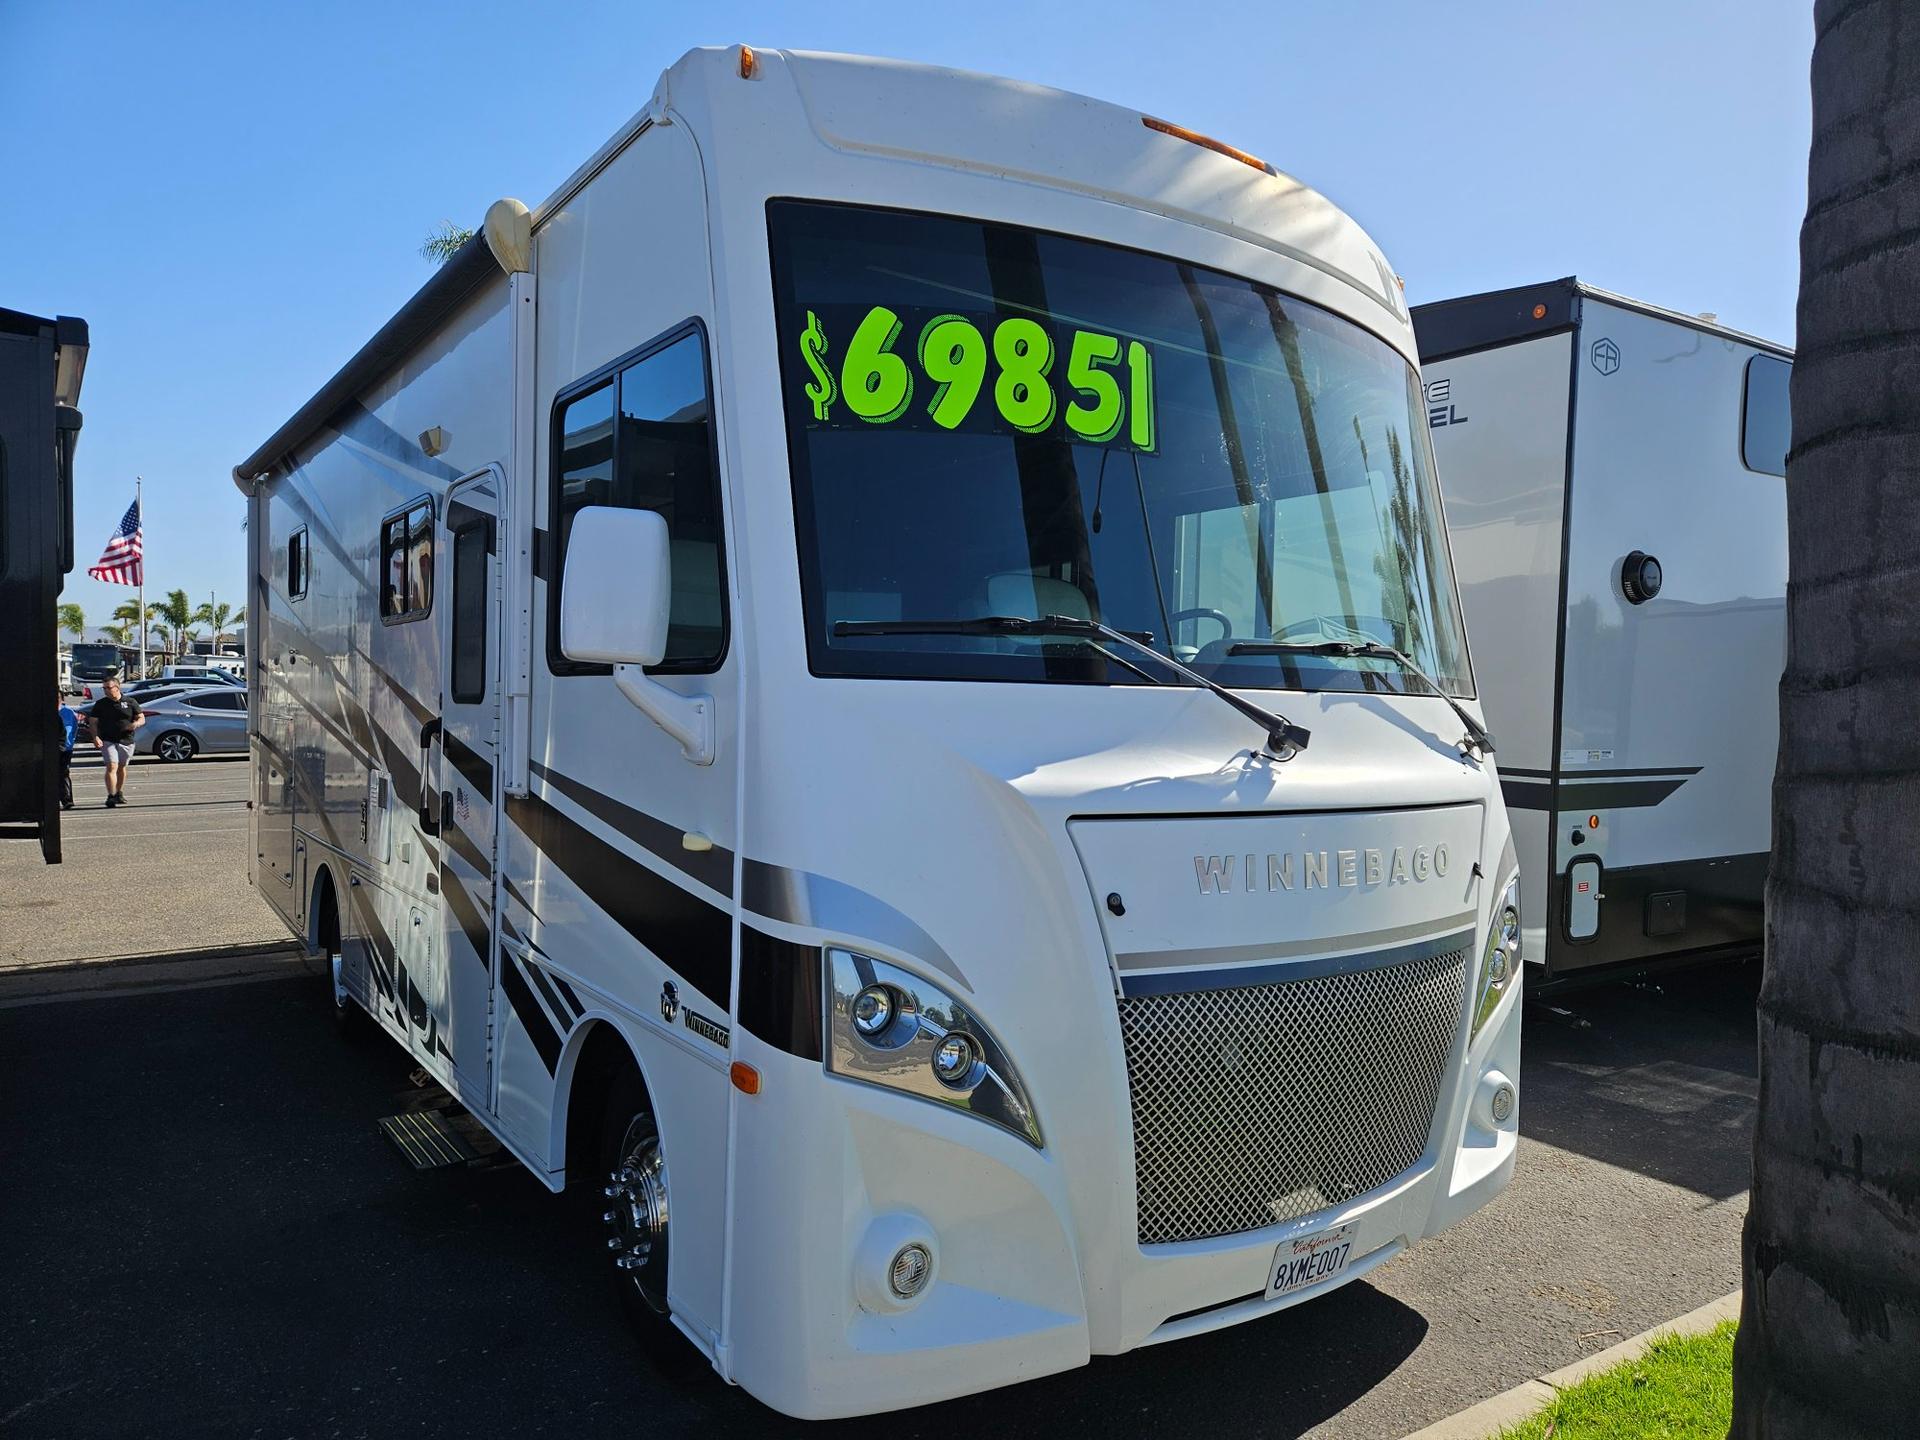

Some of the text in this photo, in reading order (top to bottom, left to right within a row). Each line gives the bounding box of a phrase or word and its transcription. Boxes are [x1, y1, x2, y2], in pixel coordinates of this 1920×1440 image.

[800, 306, 1156, 452] $69851
[1194, 843, 1450, 895] WINNEBAGO
[1273, 1243, 1351, 1290] 8XME007
[1293, 1234, 1344, 1255] California
